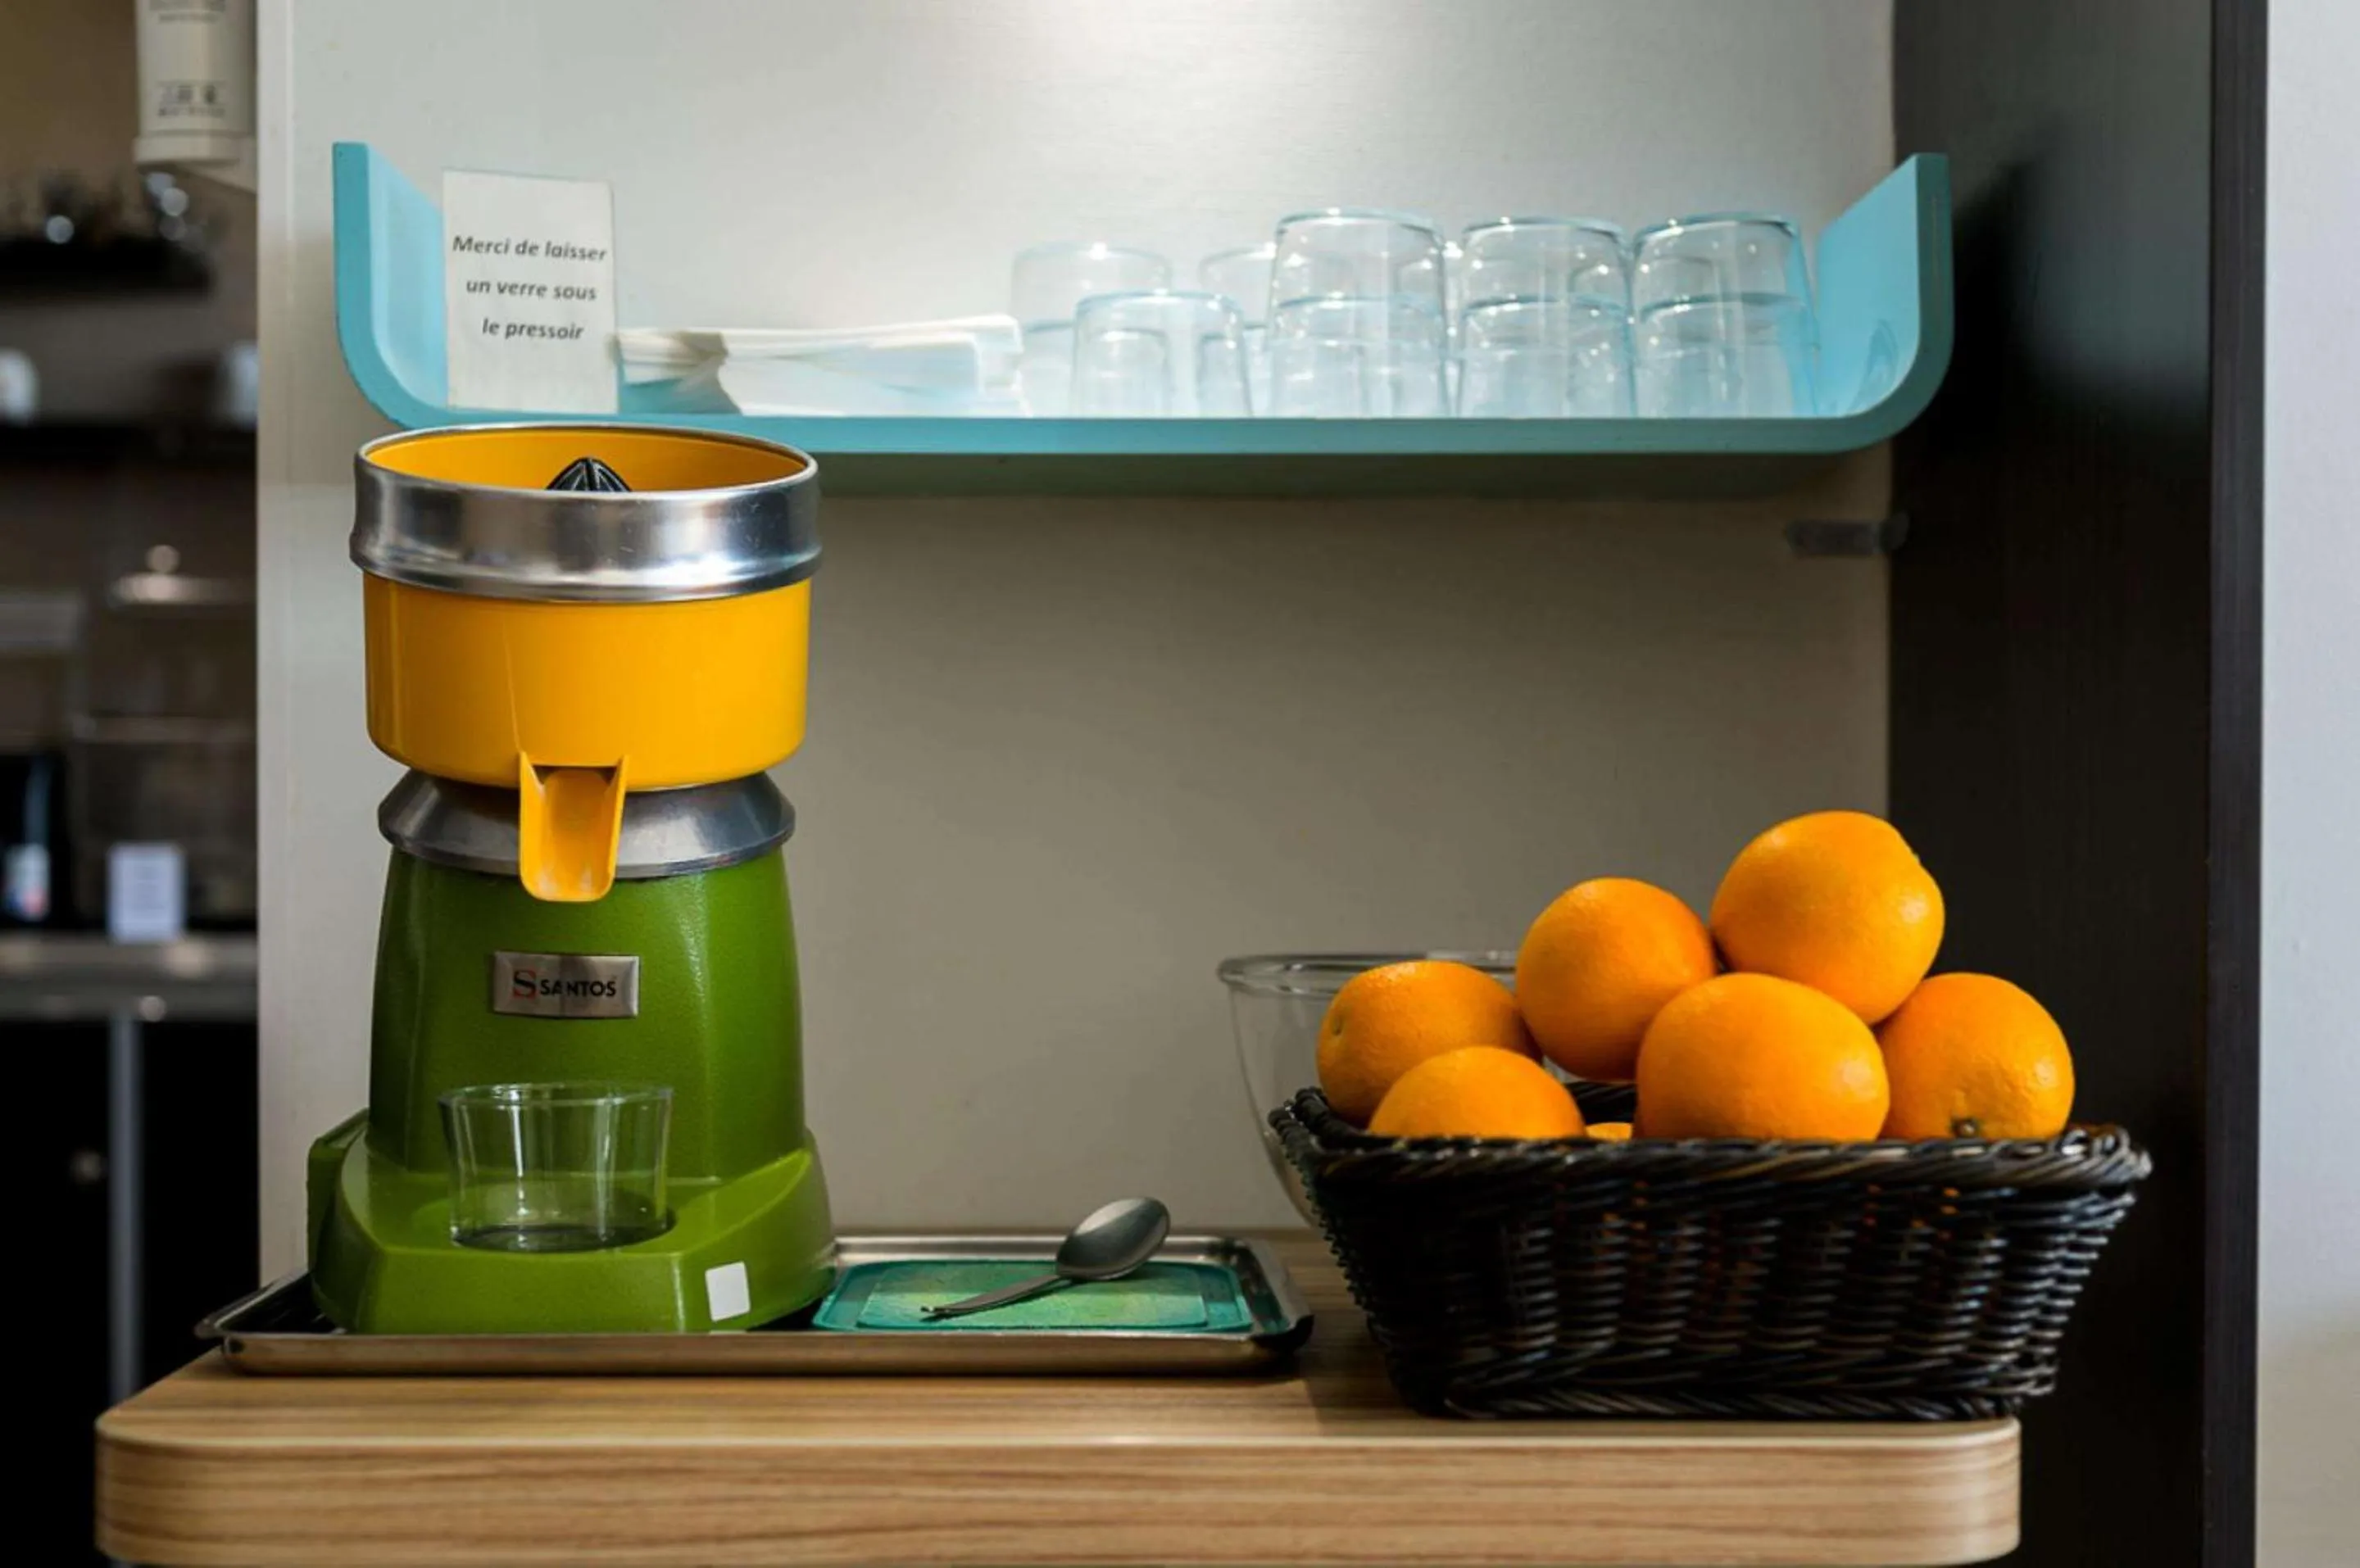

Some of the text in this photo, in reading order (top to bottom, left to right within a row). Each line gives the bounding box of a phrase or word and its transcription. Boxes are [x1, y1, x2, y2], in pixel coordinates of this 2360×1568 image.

[452, 235, 606, 261] Merci de laisser
[466, 279, 597, 300] un verre sous
[482, 318, 584, 340] le pressoir
[539, 978, 617, 997] SANTOS
